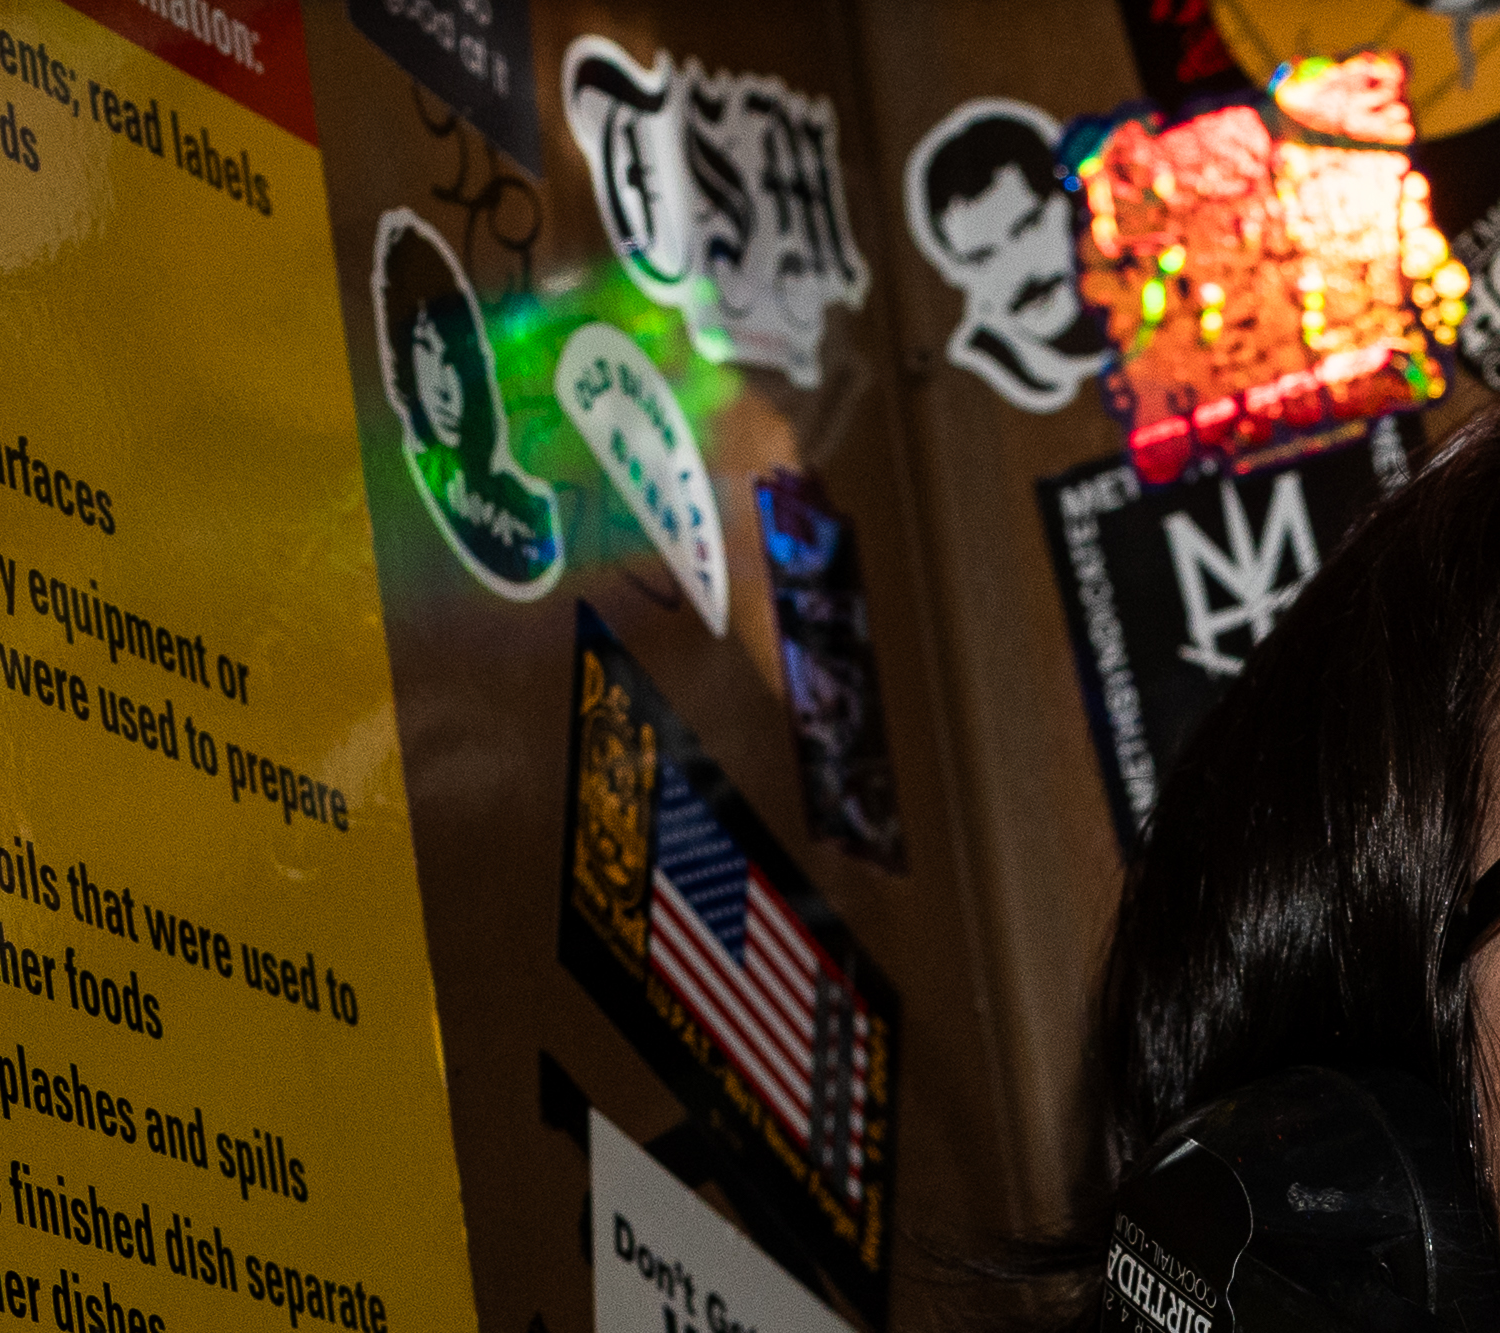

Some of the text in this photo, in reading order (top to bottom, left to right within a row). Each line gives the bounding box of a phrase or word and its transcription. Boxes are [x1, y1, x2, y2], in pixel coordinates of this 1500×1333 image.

[87, 77, 274, 216] read labels
[28, 570, 210, 691] equipment
[216, 653, 249, 707] or
[2, 656, 91, 722] were
[98, 685, 178, 763] used
[186, 717, 218, 779] to
[227, 741, 349, 834] prepare
[64, 947, 163, 1042] foods
[68, 863, 137, 944] that
[144, 903, 233, 981] were
[241, 940, 319, 1016] used
[327, 968, 358, 1028] to
[144, 1106, 208, 1170] and
[216, 1128, 308, 1206] spills
[9, 1161, 156, 1269] finished
[166, 1202, 236, 1295] dish
[615, 1212, 697, 1316] Don't
[1152, 1239, 1217, 1308] COCKTAIL
